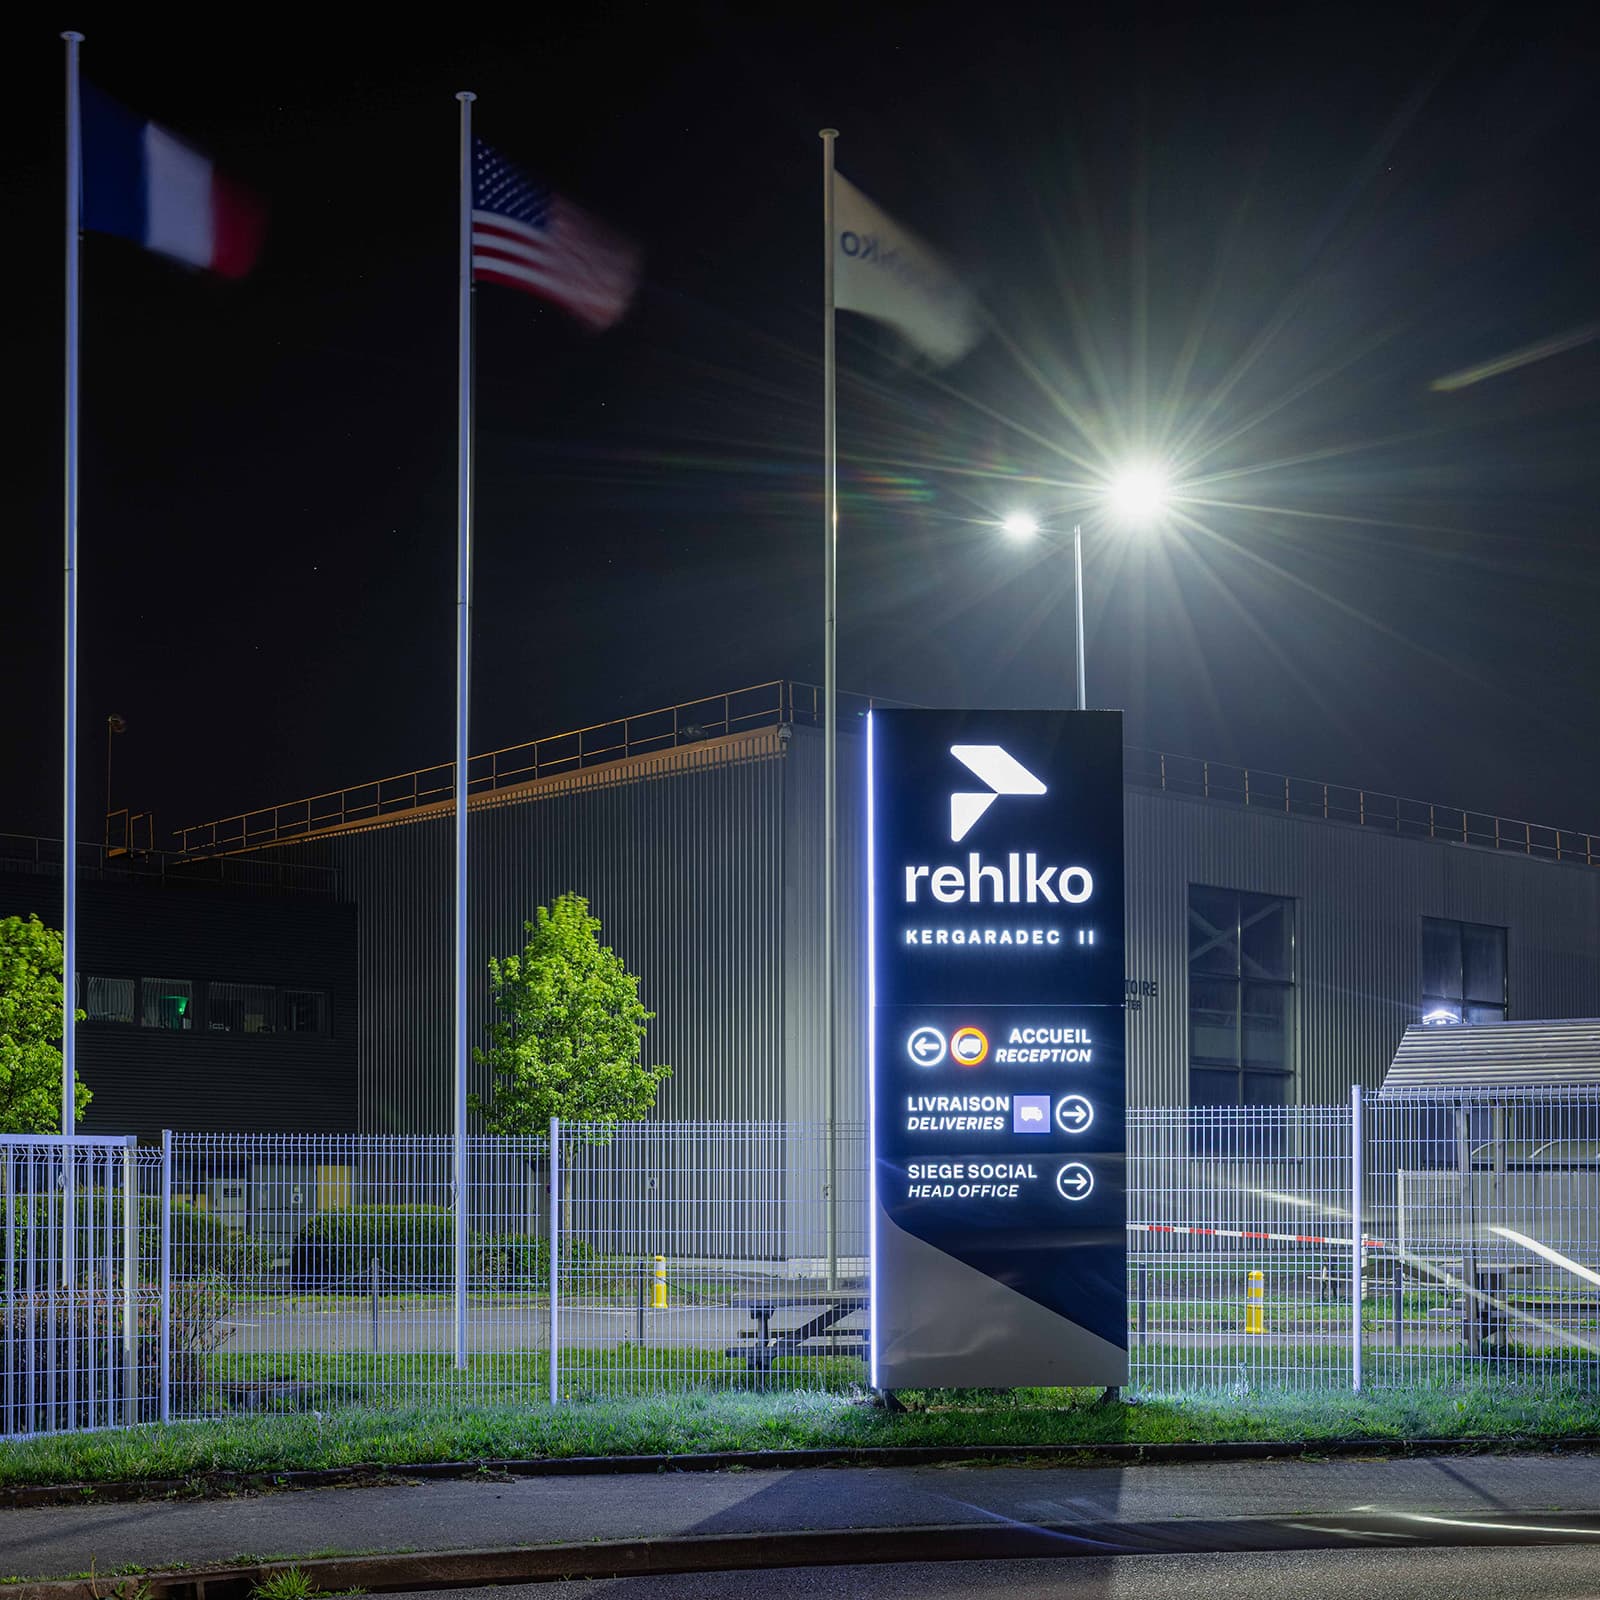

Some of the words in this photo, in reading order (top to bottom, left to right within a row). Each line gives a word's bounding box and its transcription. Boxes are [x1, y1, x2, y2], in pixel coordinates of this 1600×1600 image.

[905, 852, 1094, 904] rehlko
[905, 929, 1061, 945] KERGARADEC
[1009, 1028, 1092, 1044] ACCUEIL
[995, 1049, 1092, 1063] RECEPTION
[907, 1096, 1010, 1112] LIVRAISON
[907, 1117, 1005, 1131] DELIVERIES
[907, 1164, 964, 1179] SIEGE
[967, 1164, 1038, 1179] SOCIAL
[907, 1185, 954, 1198] HEAD
[957, 1185, 1020, 1198] OFFICE
